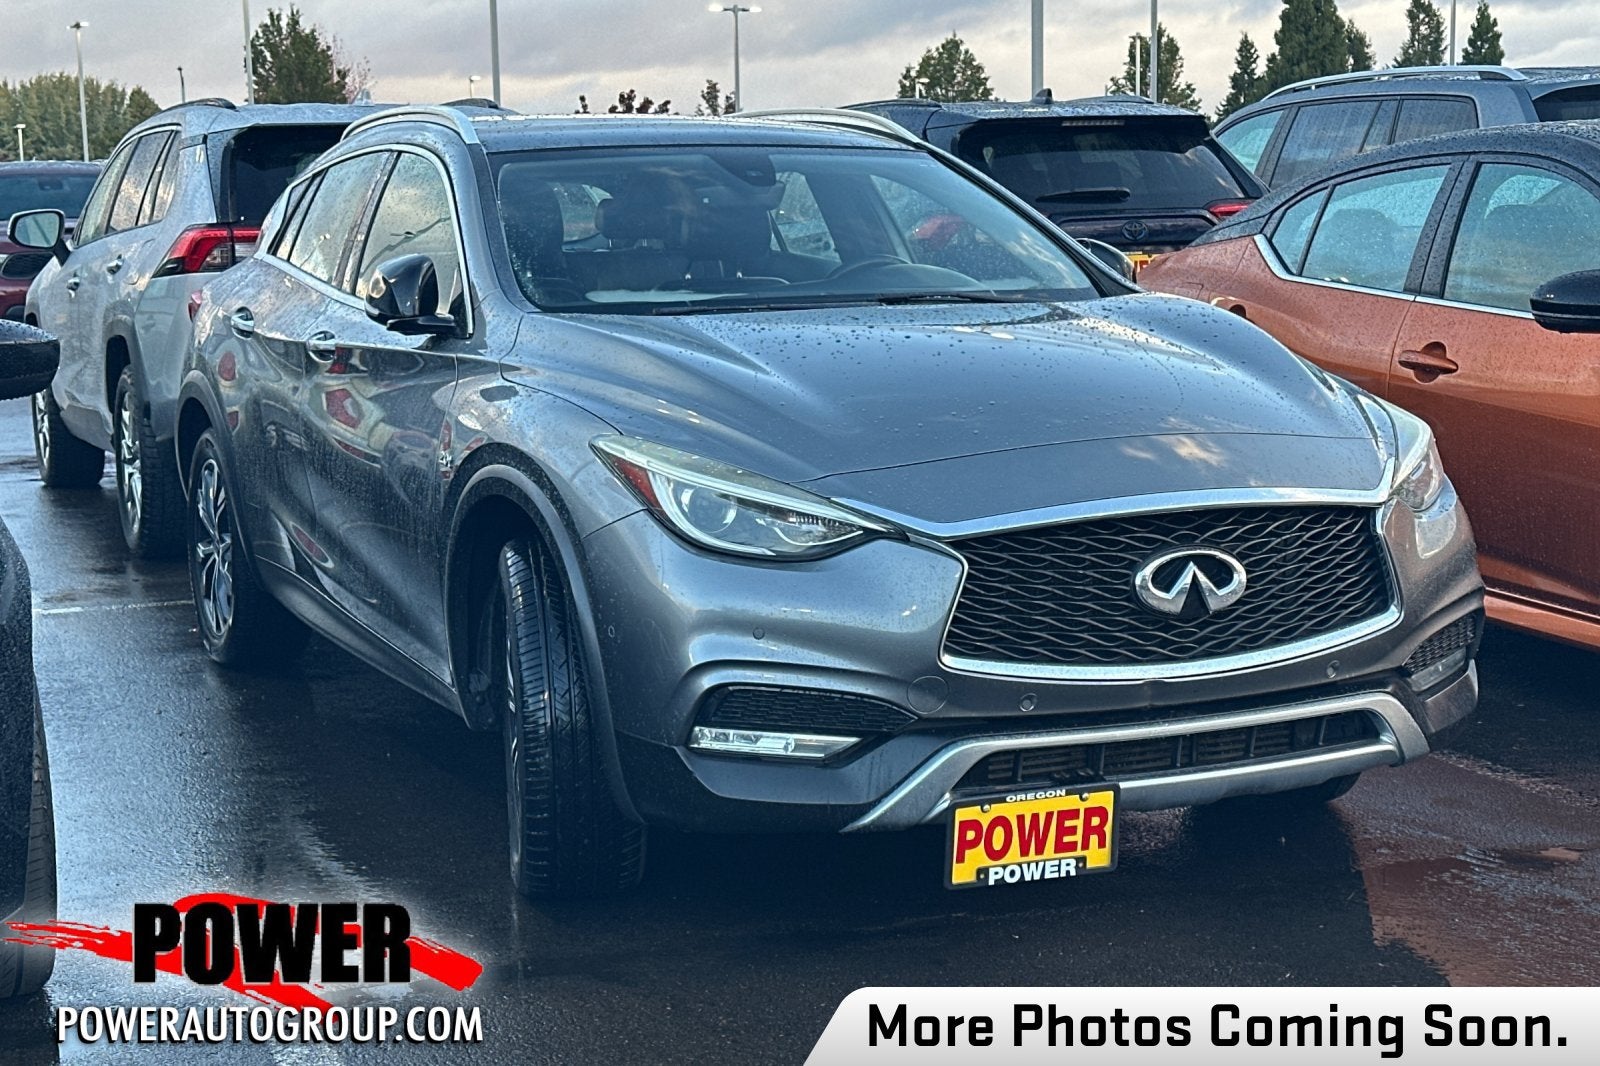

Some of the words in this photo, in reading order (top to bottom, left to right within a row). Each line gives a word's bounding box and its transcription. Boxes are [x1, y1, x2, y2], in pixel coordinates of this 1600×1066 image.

[1005, 789, 1066, 803] OREGON
[955, 805, 1109, 865] POWER
[988, 858, 1077, 886] POWER
